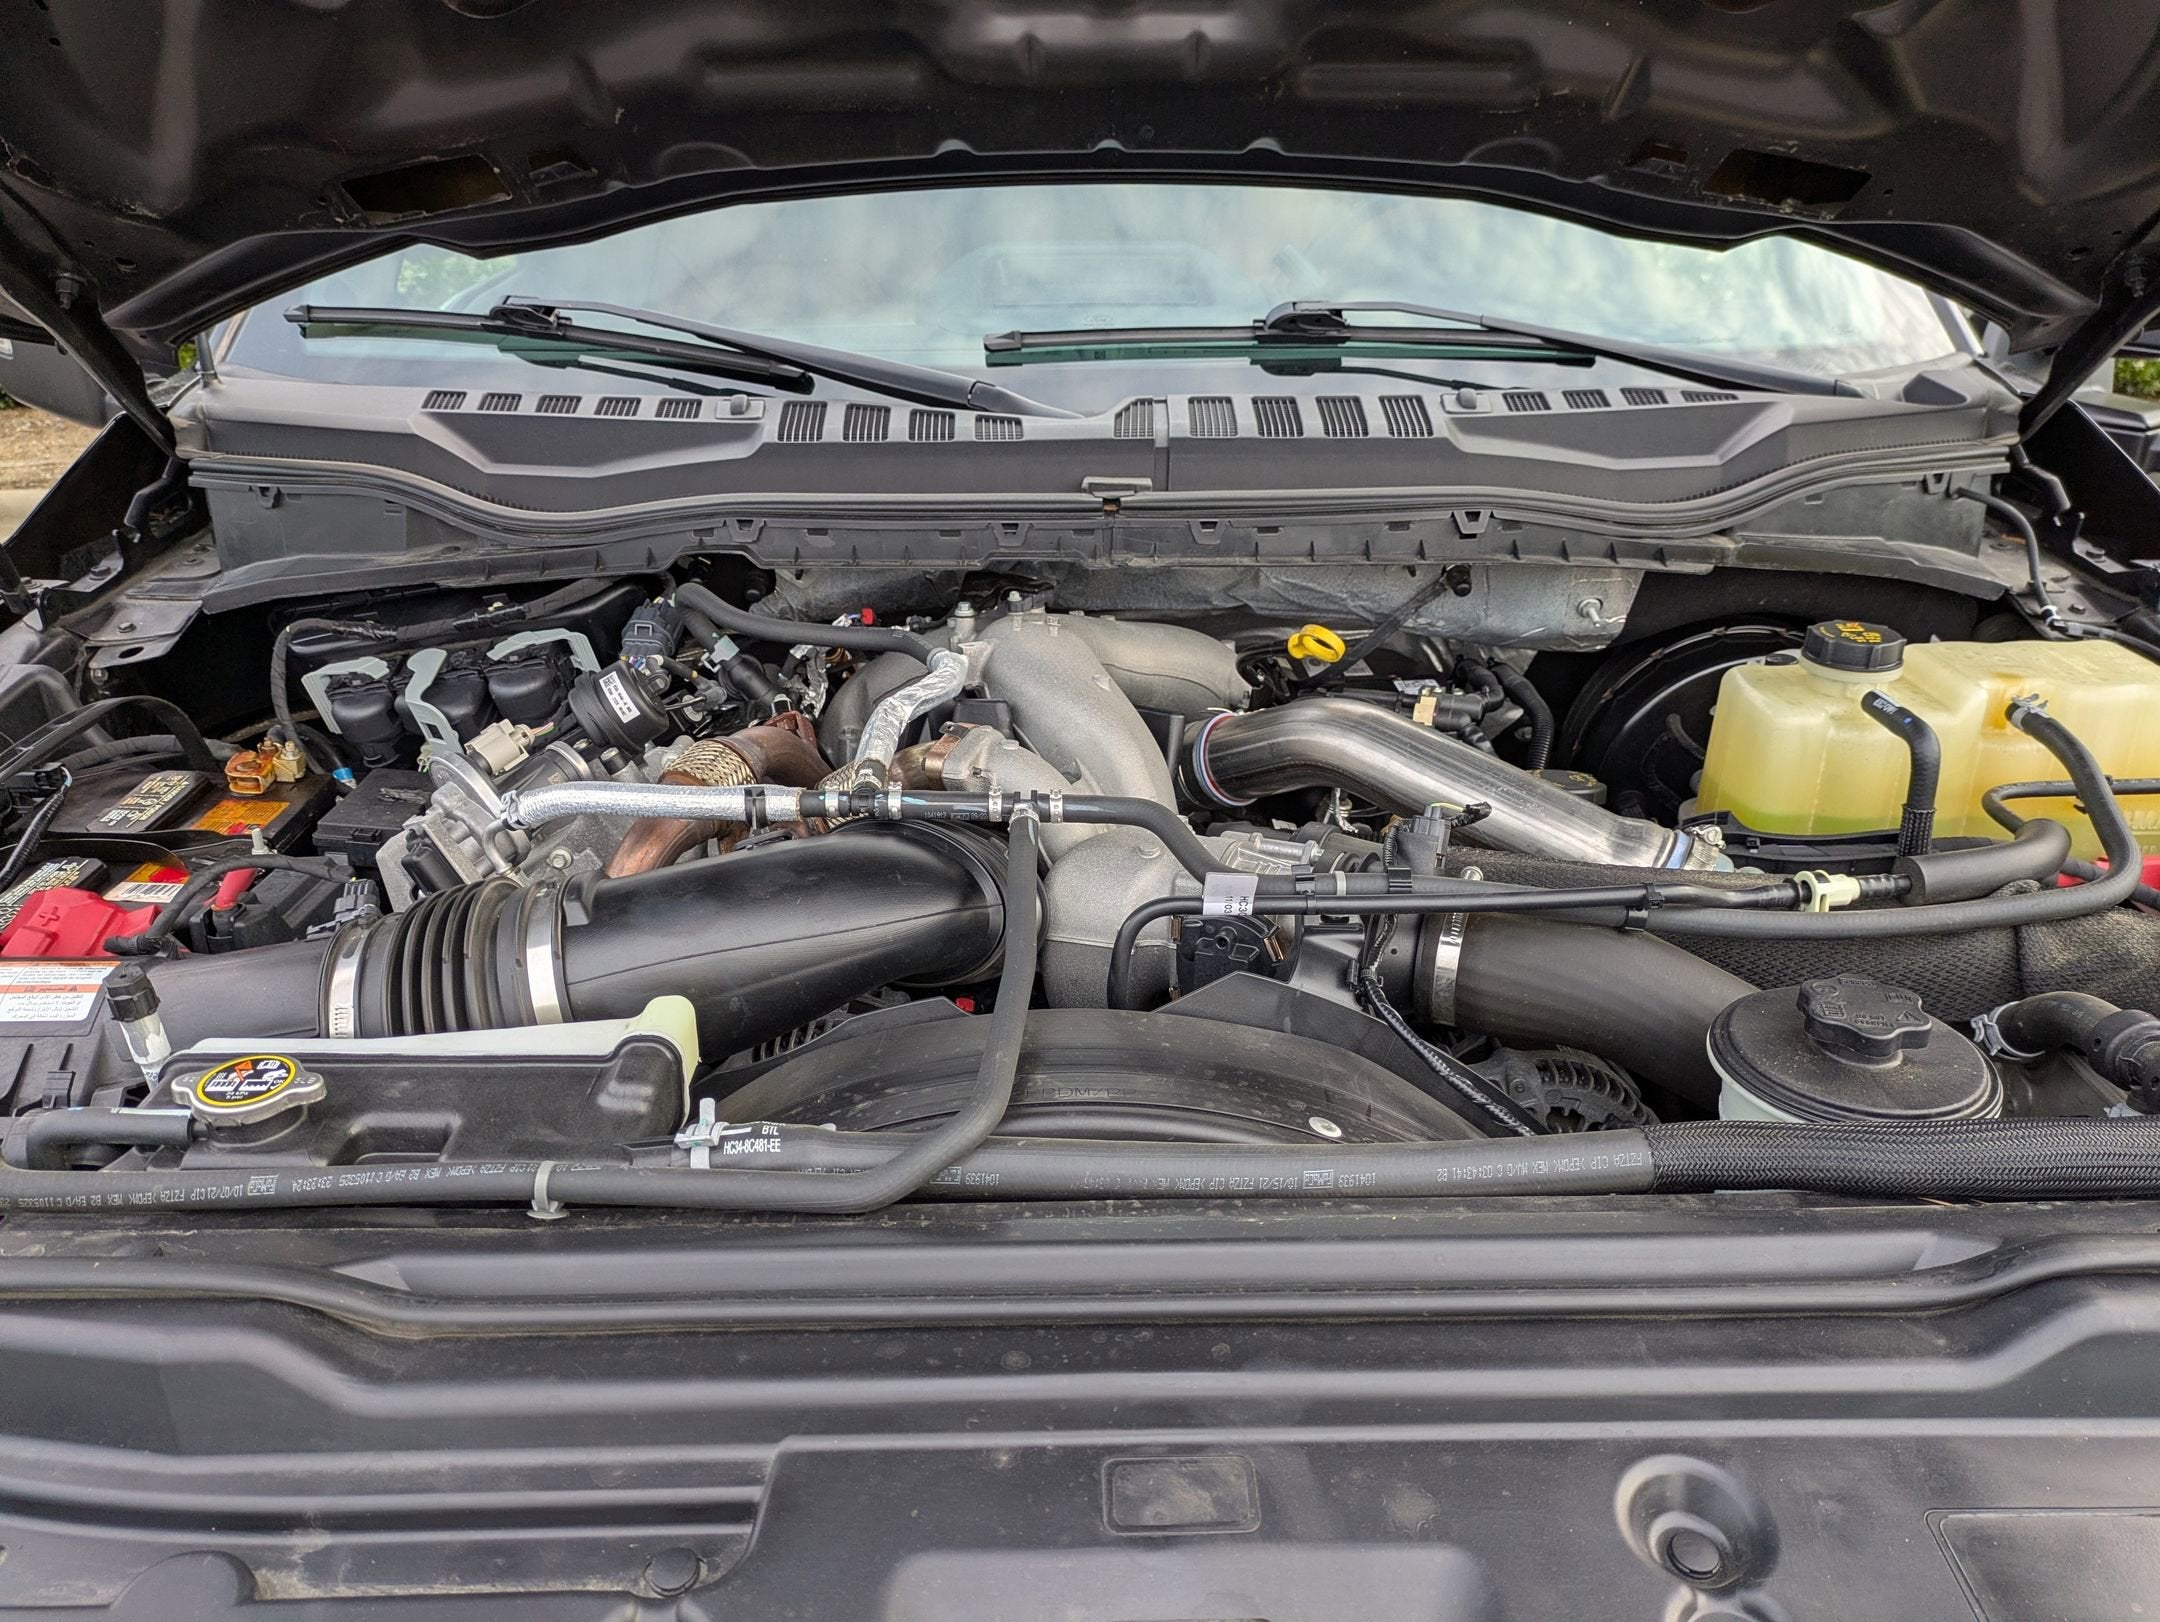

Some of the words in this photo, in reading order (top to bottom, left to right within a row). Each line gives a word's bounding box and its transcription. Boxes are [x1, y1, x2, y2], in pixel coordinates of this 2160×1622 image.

[723, 1138, 781, 1155] HC34-8C481-EE
[964, 1172, 1000, 1187] 1041939
[1258, 1176, 1298, 1190] 10/15/21
[1338, 1172, 1377, 1187] 1041939
